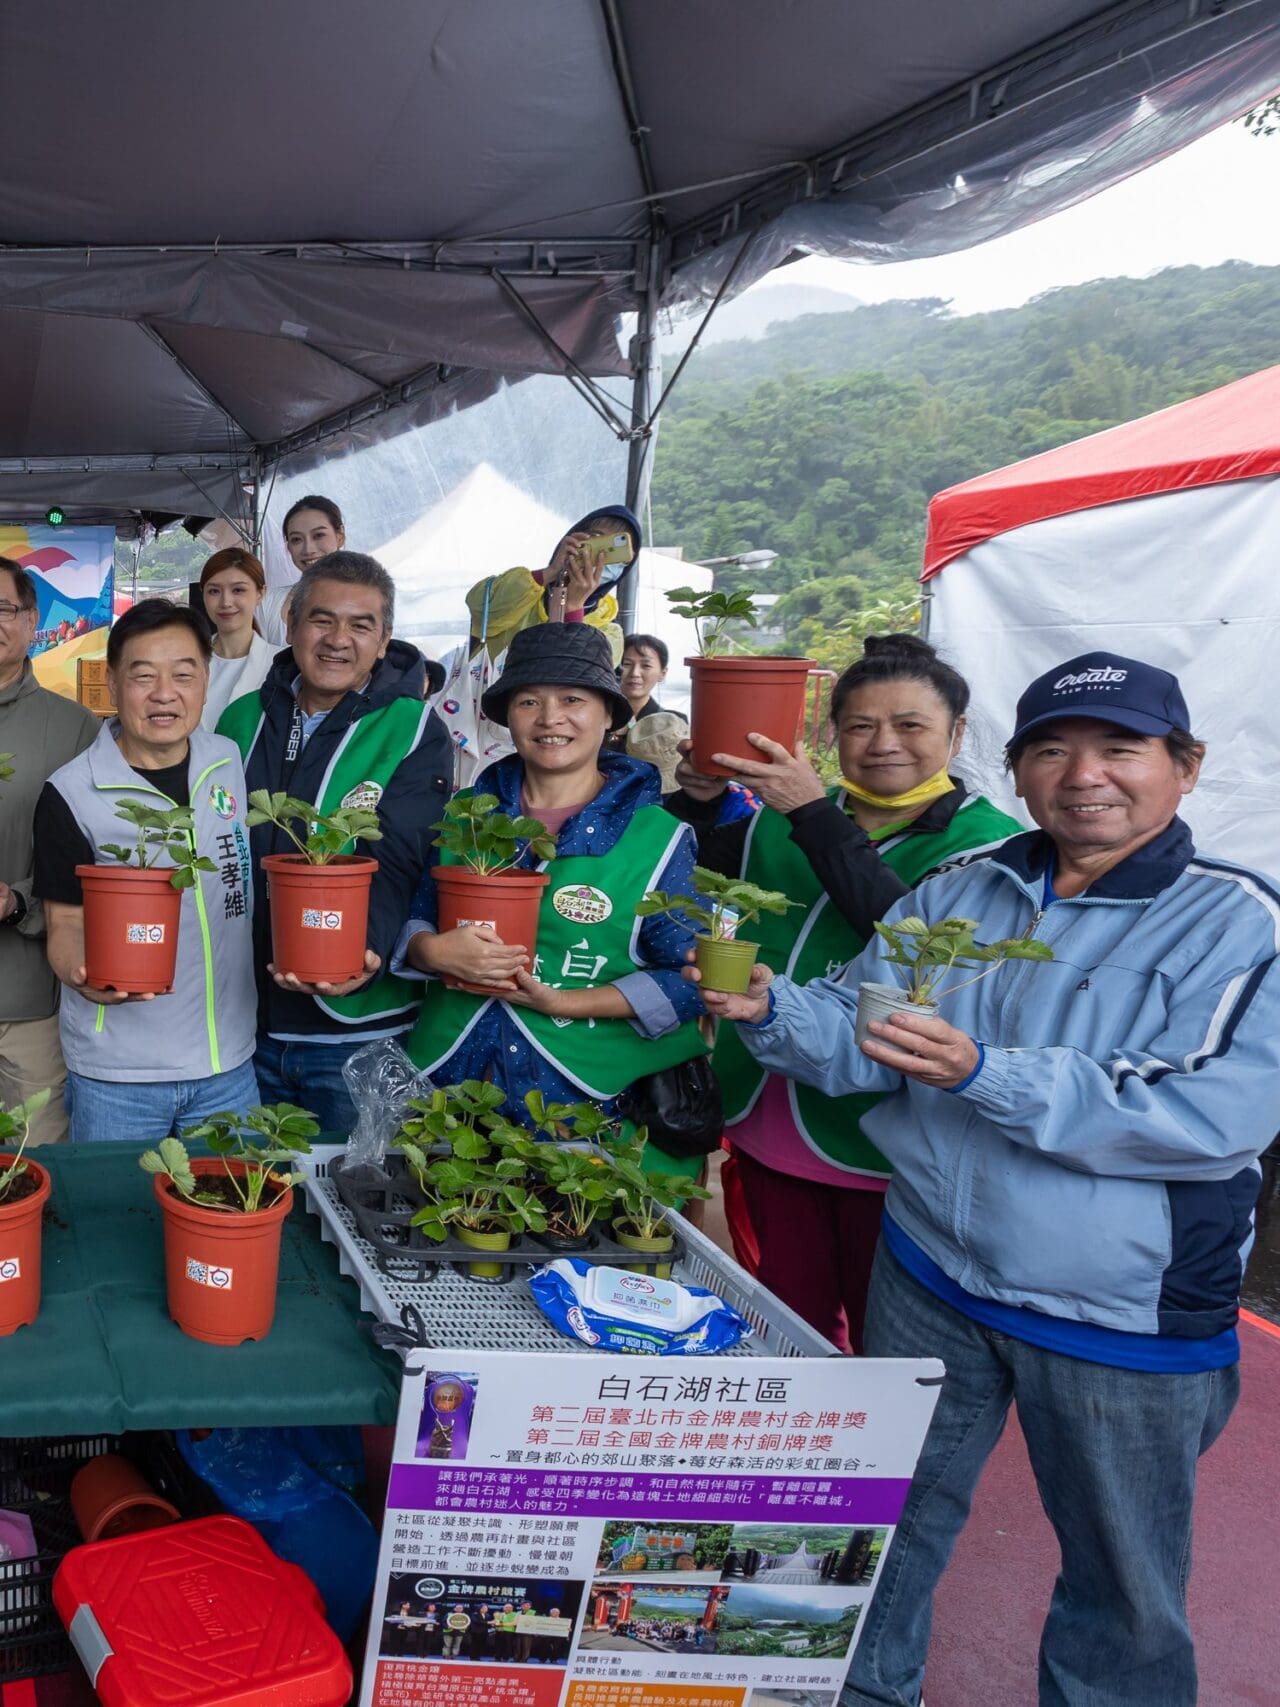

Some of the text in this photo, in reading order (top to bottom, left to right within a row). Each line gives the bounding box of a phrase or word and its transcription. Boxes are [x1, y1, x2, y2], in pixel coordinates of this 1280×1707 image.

[1053, 666, 1128, 689] Create
[216, 834, 245, 920] 王孝維
[599, 1374, 792, 1403] 白石湖社區
[530, 1405, 868, 1430] 第二屆臺北市金牌農村金牌獎
[525, 1428, 834, 1452] 第二屆全國金牌農村銅牌獎
